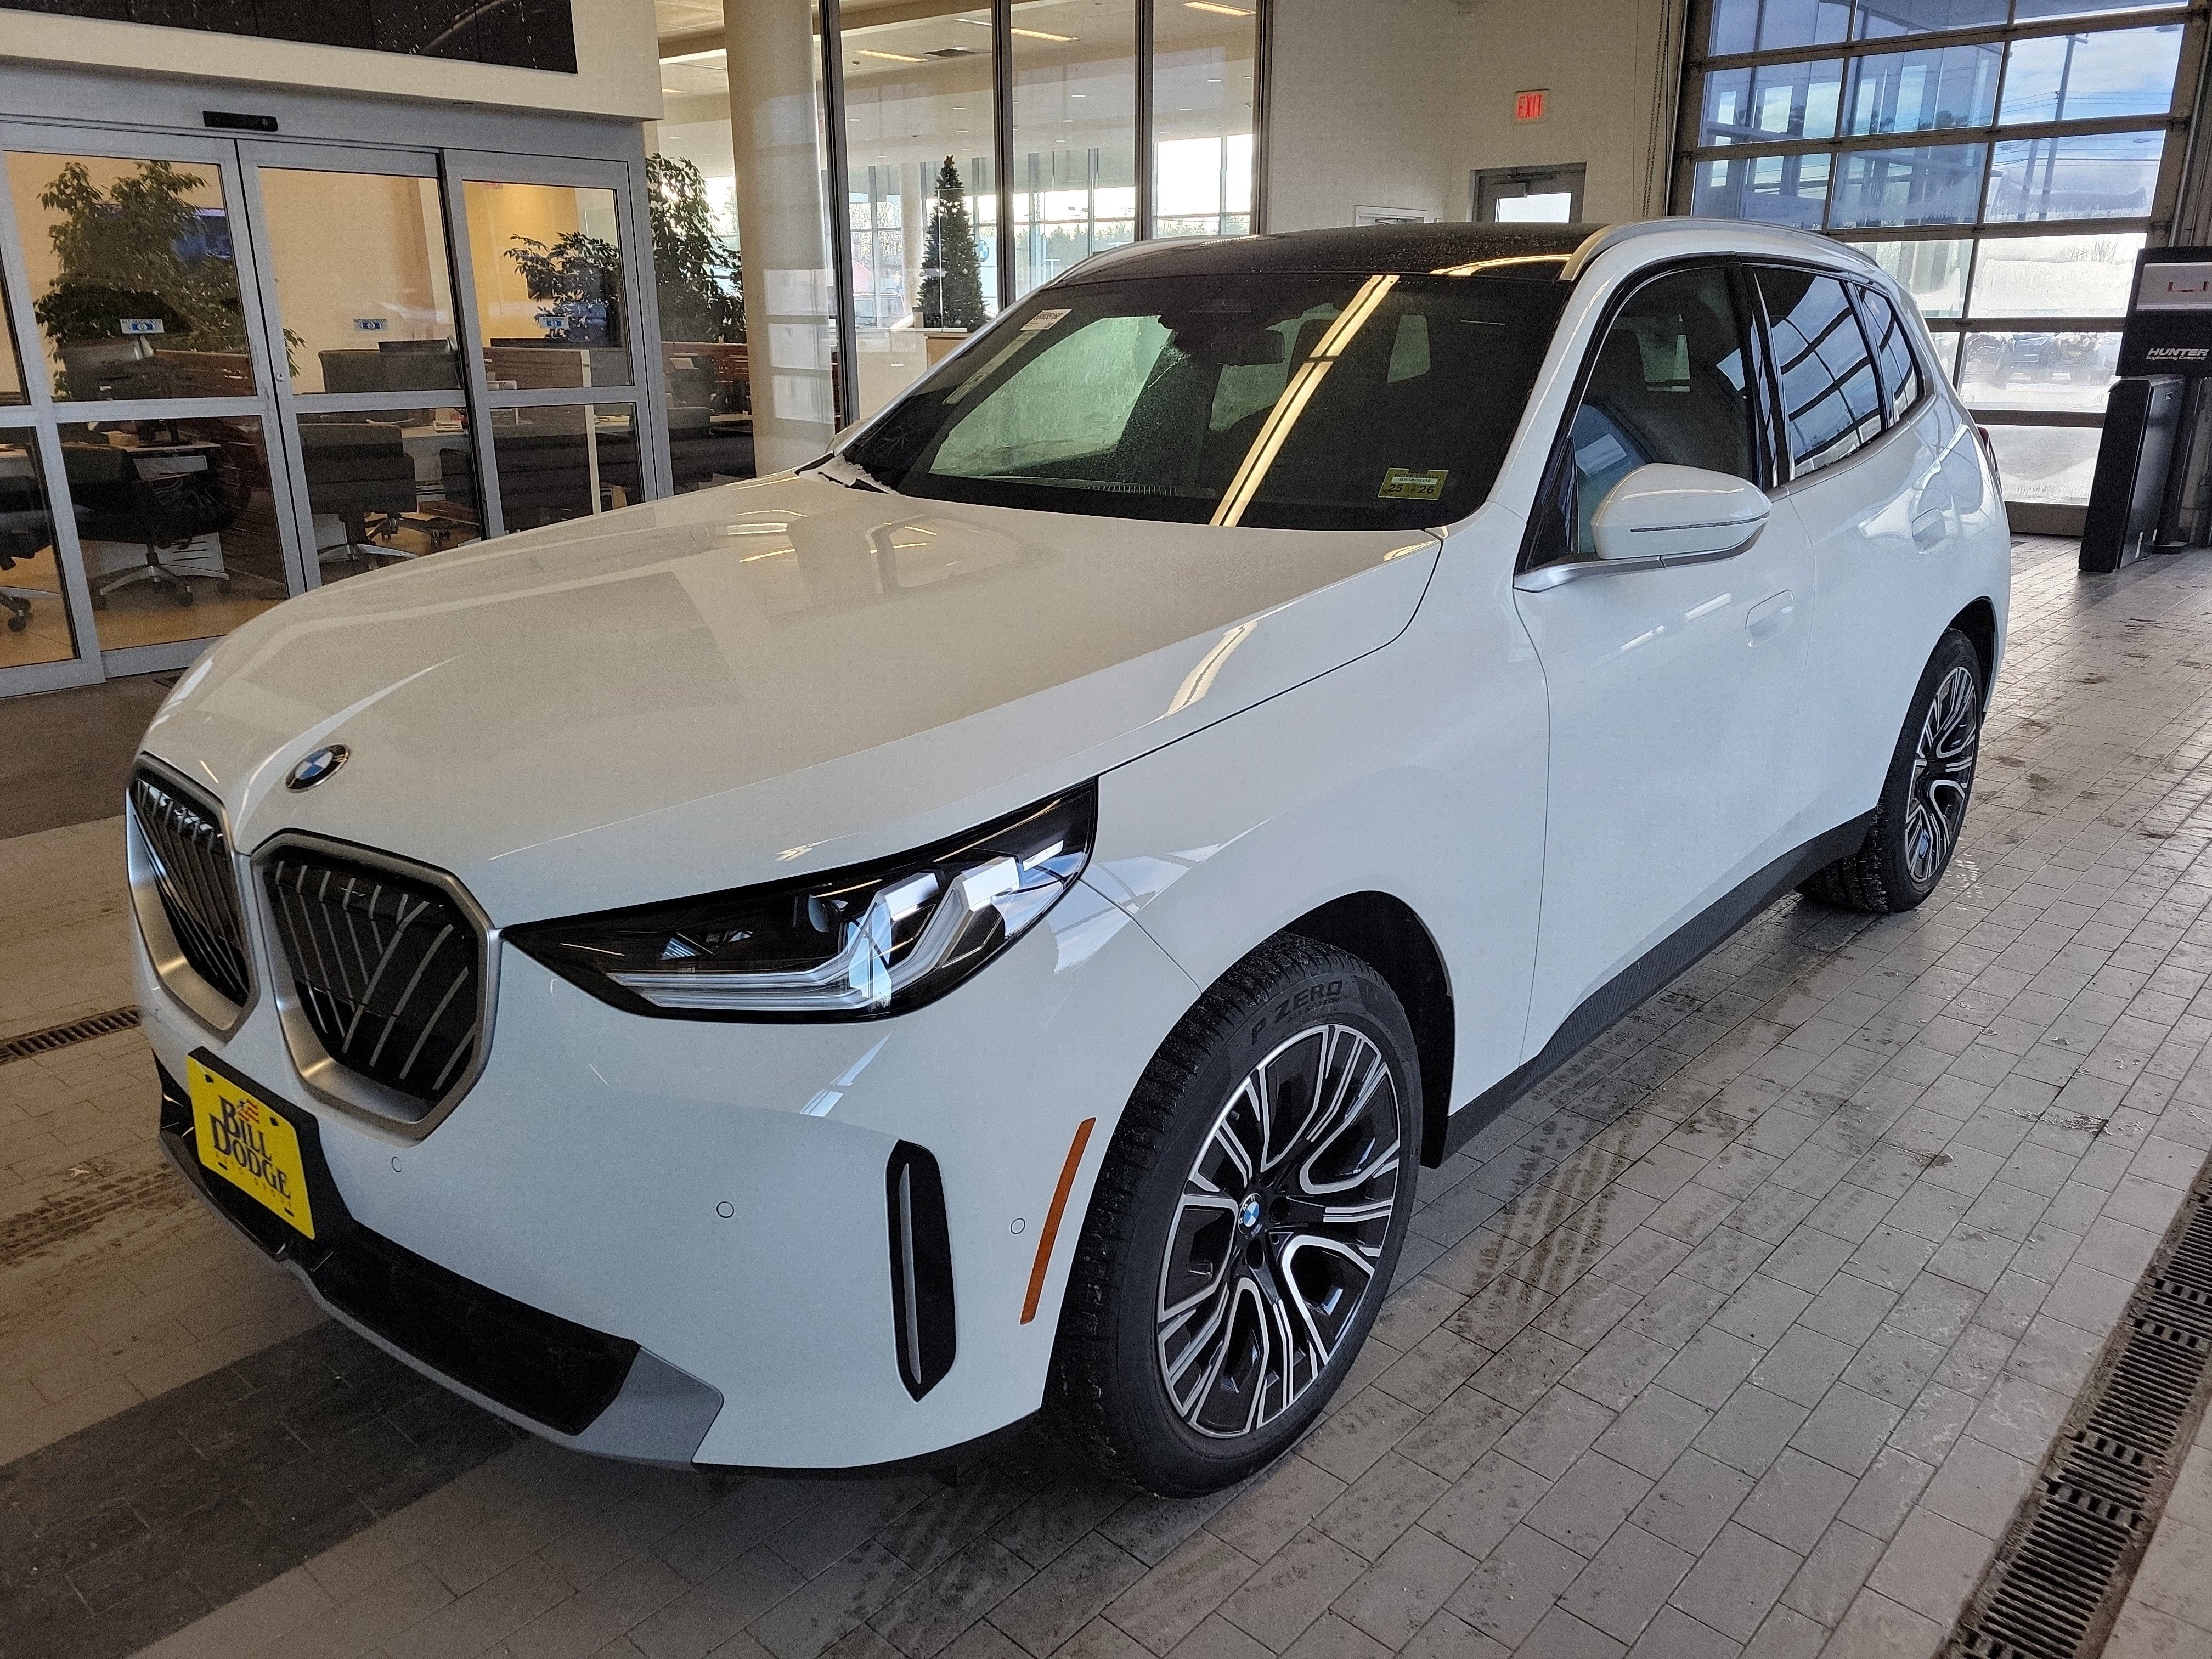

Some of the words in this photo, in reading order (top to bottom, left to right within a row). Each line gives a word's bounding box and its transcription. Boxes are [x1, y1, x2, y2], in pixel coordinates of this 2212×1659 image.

[1517, 94, 1543, 119] EXIT
[2147, 348, 2209, 356] HUNTER
[1387, 483, 1404, 492] 25
[1418, 485, 1435, 494] 26
[1251, 1017, 1267, 1045] P
[1274, 980, 1343, 1024] ZERO
[1286, 1010, 1304, 1024] ALL
[1305, 997, 1340, 1012] SEASON
[218, 1094, 272, 1161] BILL
[208, 1112, 291, 1200] DODGE
[1239, 1194, 1256, 1224] BMW
